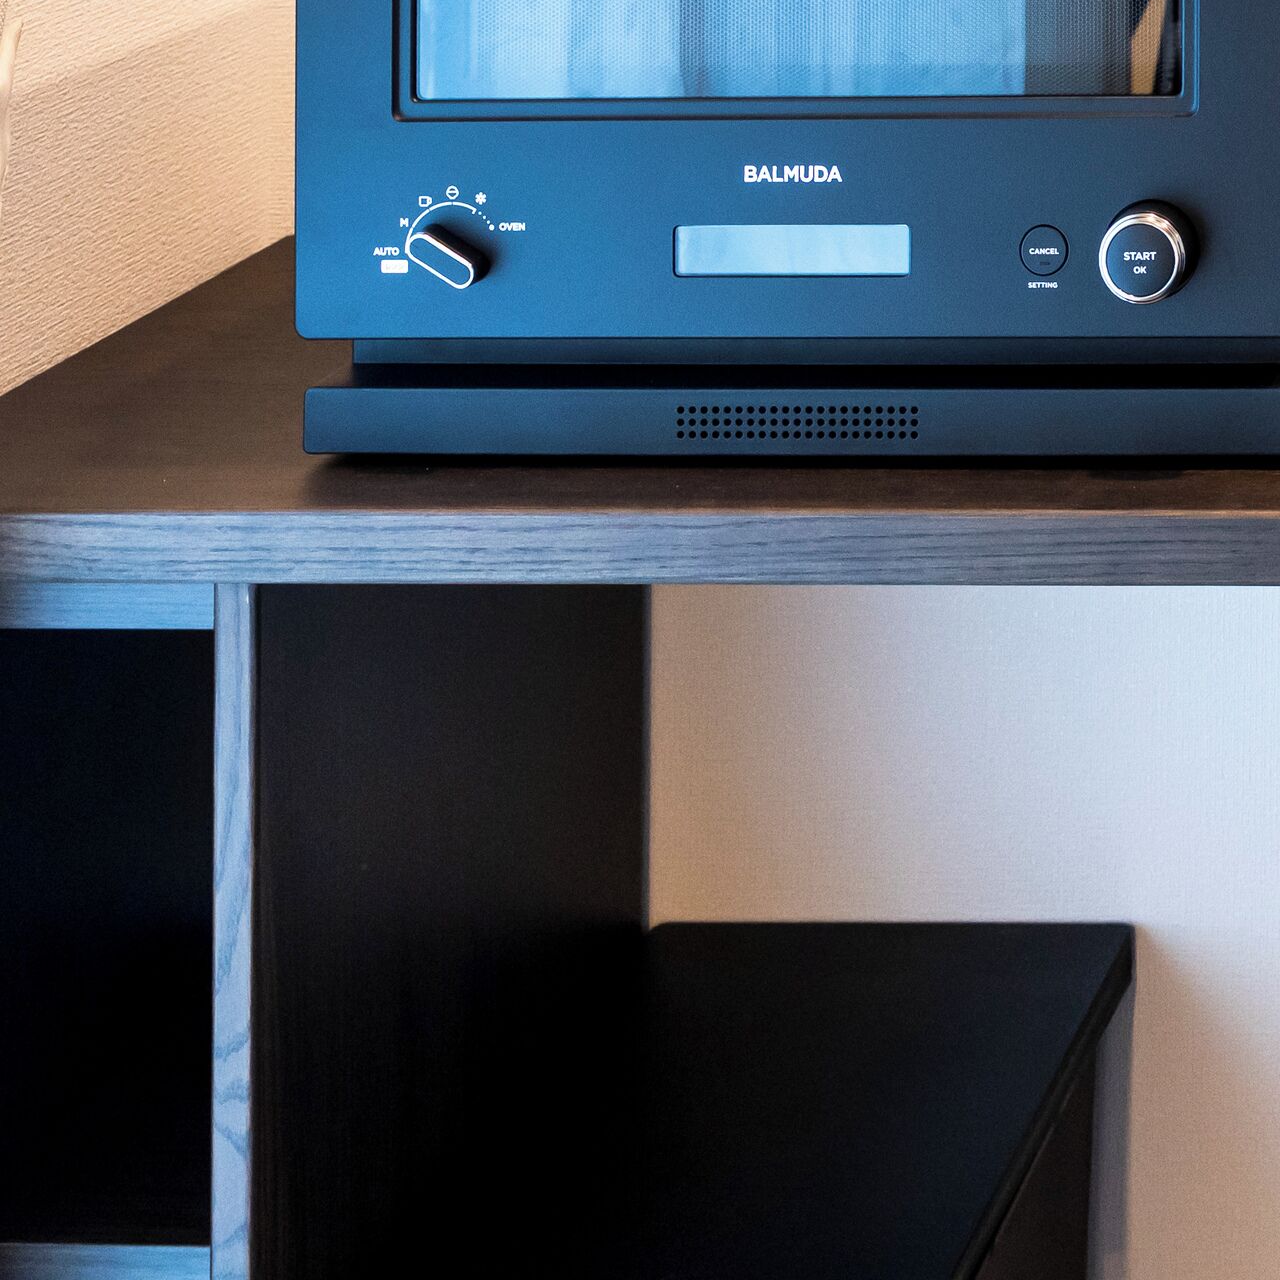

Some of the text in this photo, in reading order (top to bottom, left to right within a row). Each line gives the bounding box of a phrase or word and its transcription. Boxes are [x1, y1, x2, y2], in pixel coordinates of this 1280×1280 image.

[743, 164, 843, 183] BALMUDA
[399, 218, 409, 227] M
[499, 222, 526, 232] OVEN
[373, 247, 400, 257] AUTO
[1029, 247, 1060, 256] CANCEL
[1123, 252, 1157, 261] START
[1133, 265, 1147, 274] OK
[1028, 281, 1059, 289] SETTING
